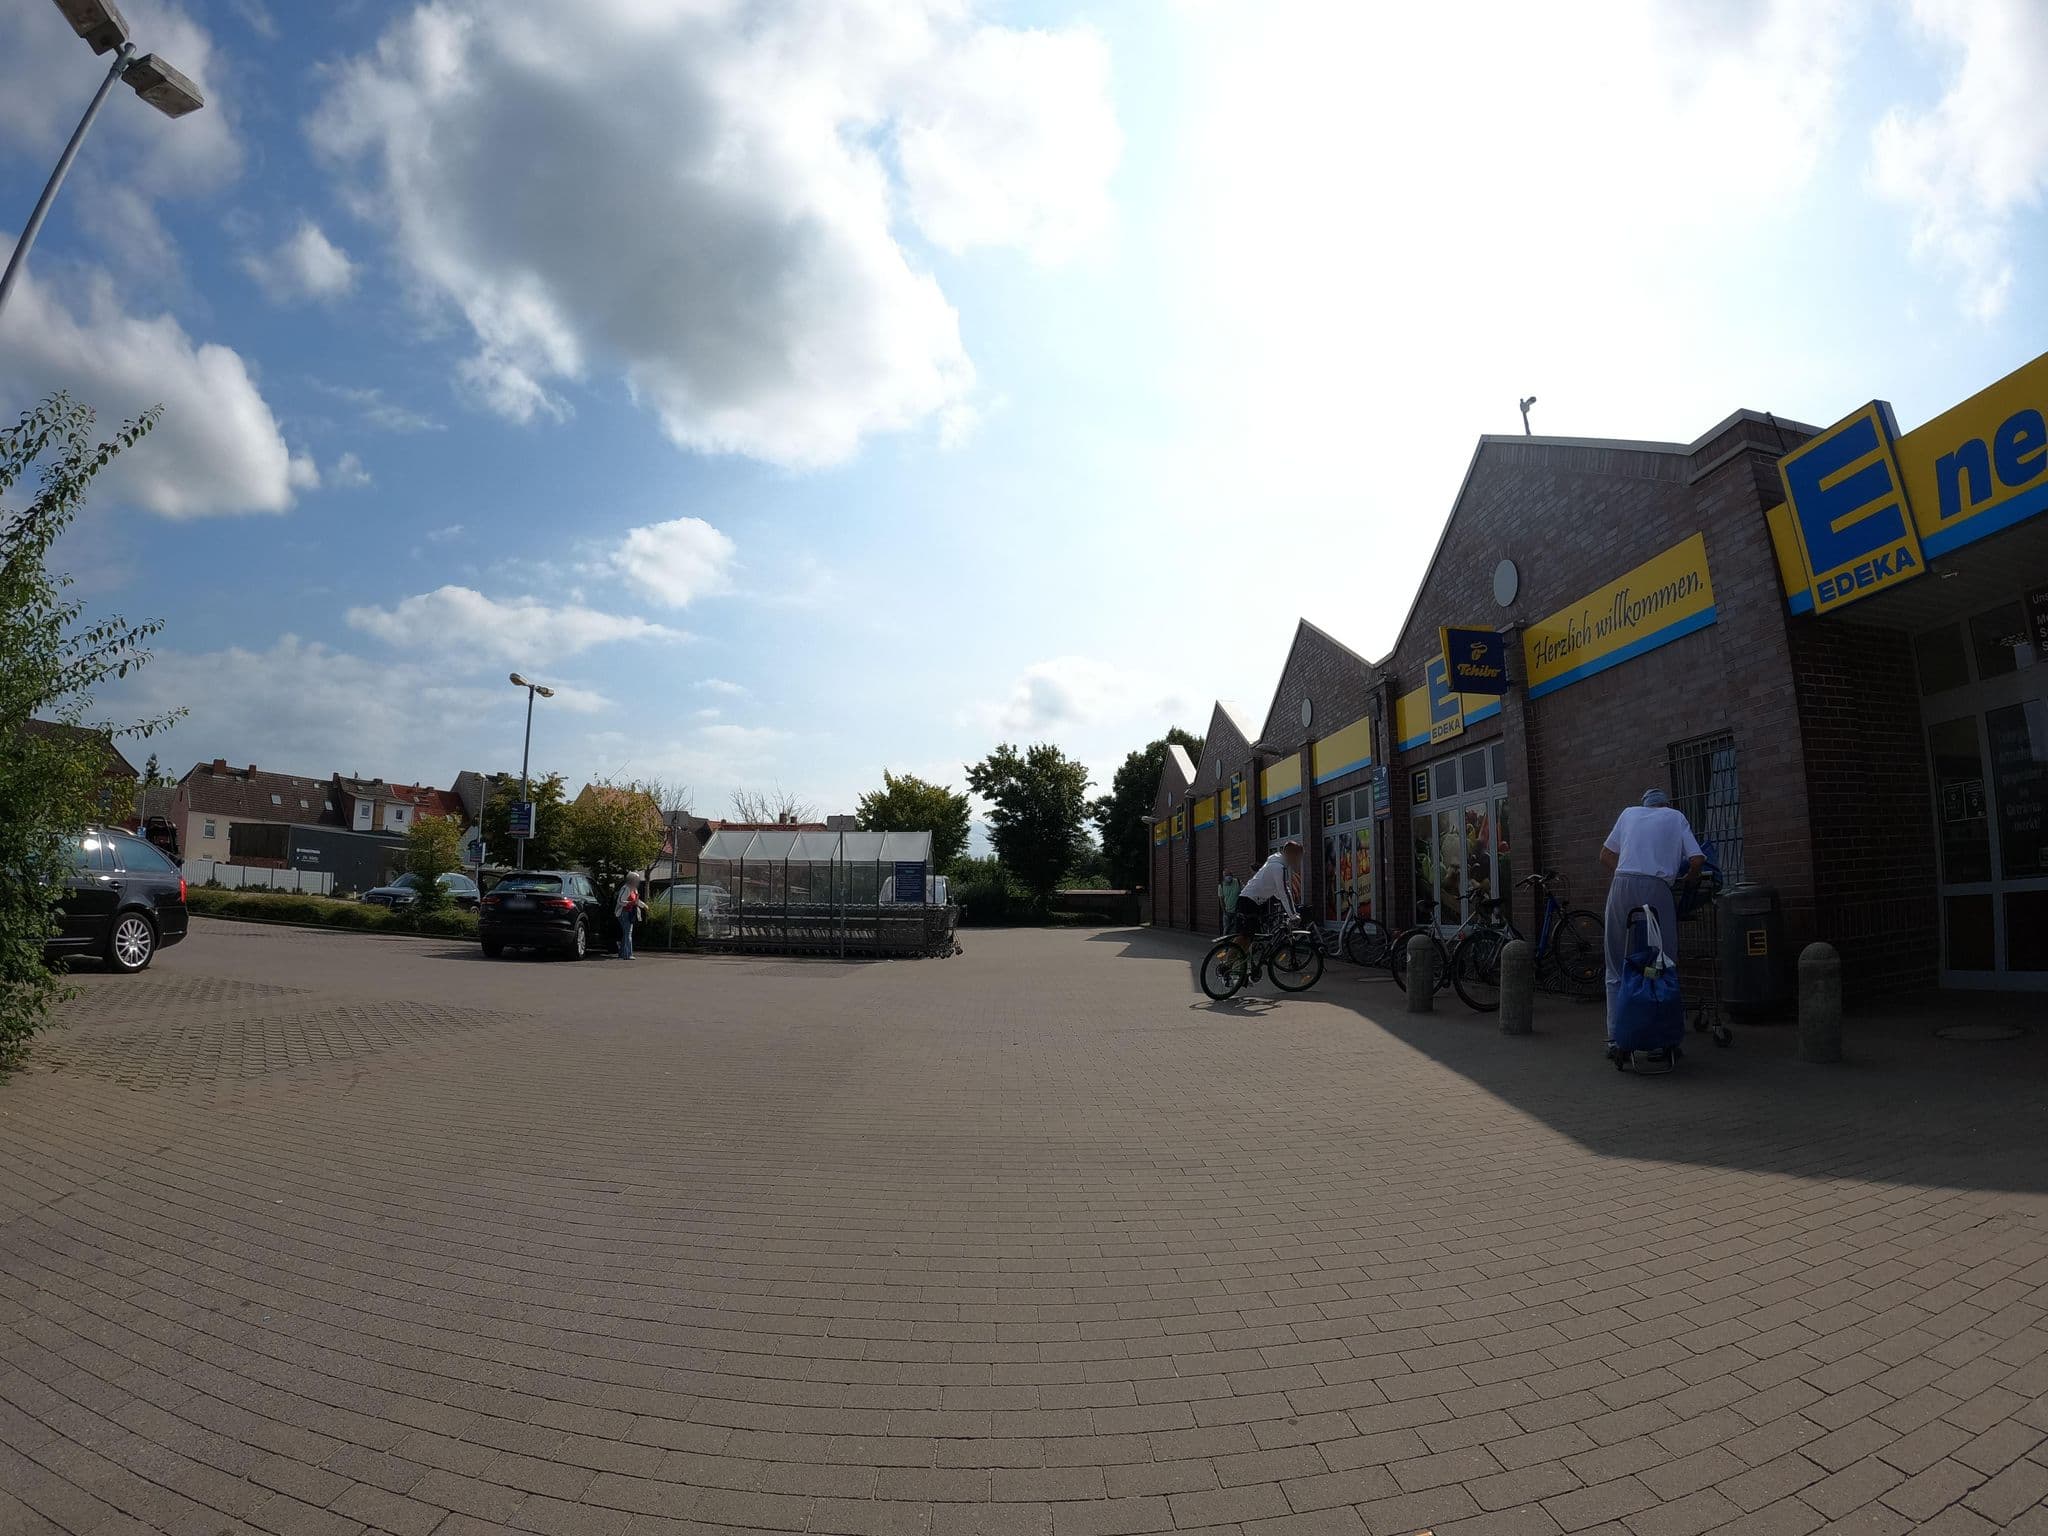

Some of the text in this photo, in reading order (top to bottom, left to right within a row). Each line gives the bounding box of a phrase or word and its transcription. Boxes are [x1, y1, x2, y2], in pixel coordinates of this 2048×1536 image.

[1935, 408, 2048, 520] ne
[1816, 546, 1916, 604] EDEKA
[1533, 568, 1704, 669] Herzlich willkommen.
[1457, 663, 1502, 678] Tchibo
[1432, 718, 1462, 739] EDEKA
